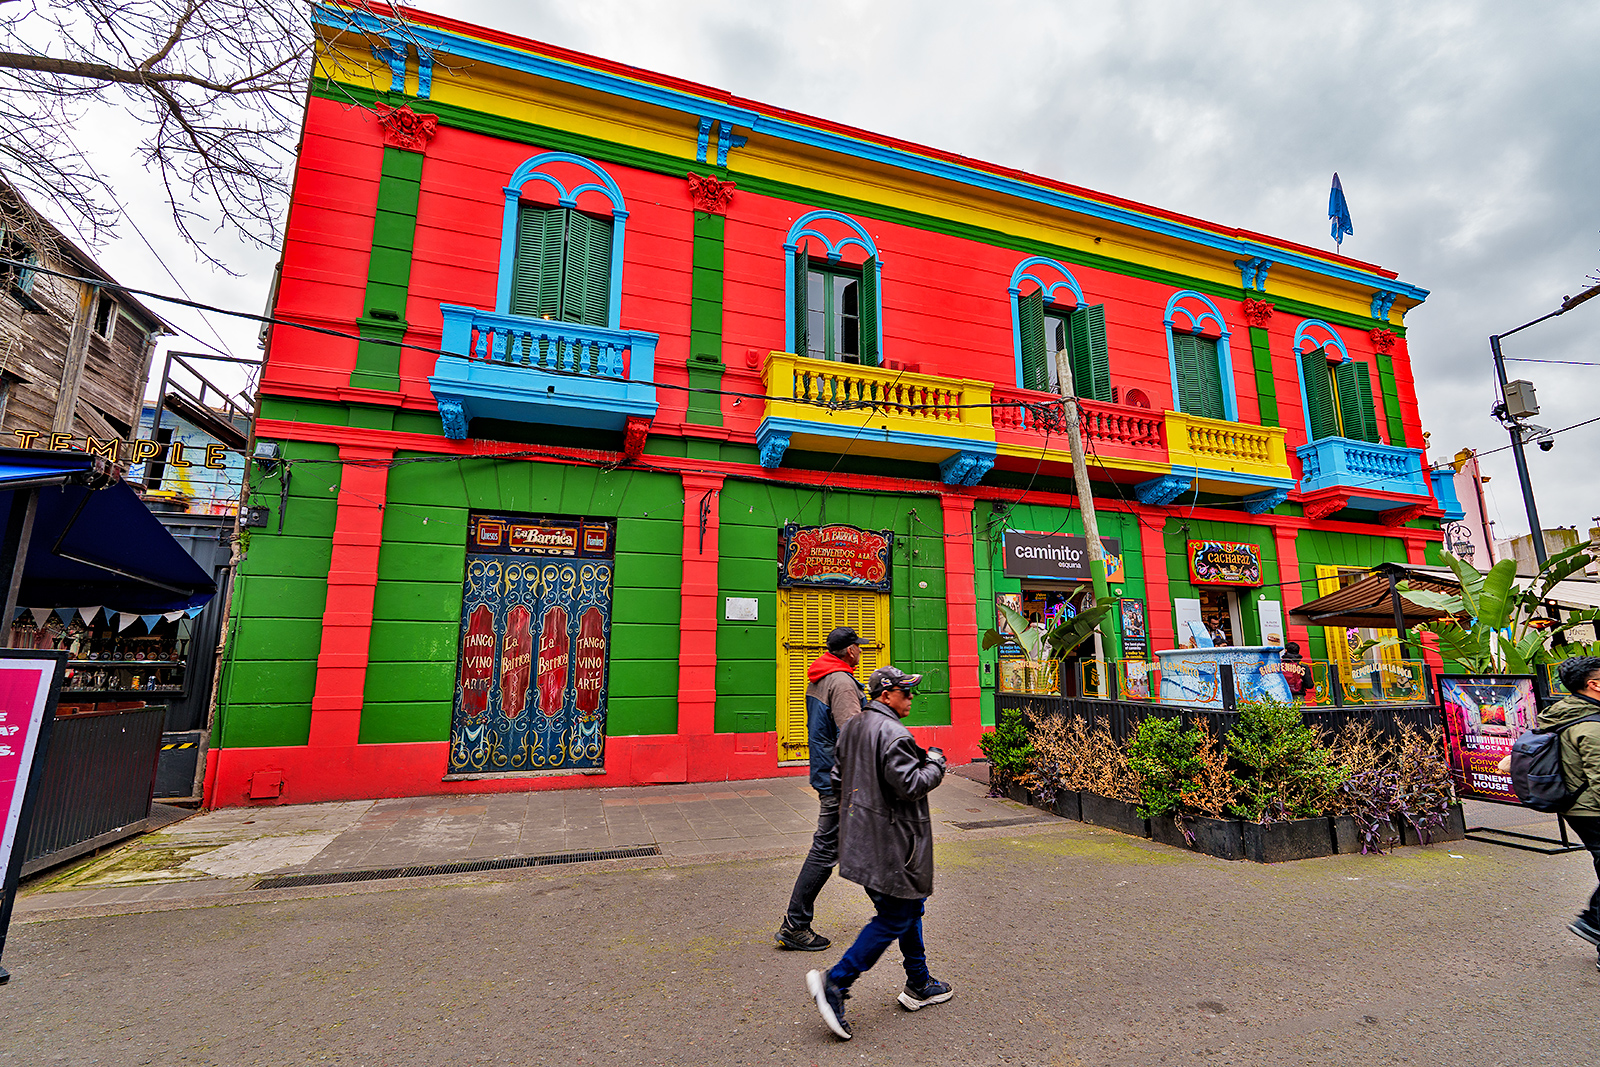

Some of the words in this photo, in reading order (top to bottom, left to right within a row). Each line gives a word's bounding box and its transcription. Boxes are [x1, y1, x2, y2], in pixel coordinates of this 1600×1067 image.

[14, 429, 228, 469] TEMPLE
[513, 528, 528, 539] La
[523, 529, 573, 546] Barrica
[821, 532, 831, 543] LA
[832, 531, 859, 544] BARRICA
[510, 547, 576, 556] VINOS
[1015, 544, 1080, 562] caminito
[806, 557, 851, 567] REPUBLICA
[1058, 561, 1082, 569] esquina
[823, 566, 853, 576] BOCA
[465, 634, 494, 648] TANGO
[504, 635, 518, 652] La
[540, 635, 555, 652] La
[578, 636, 605, 650] TANGO
[466, 656, 493, 669] VINO
[502, 653, 531, 675] Barrica
[538, 653, 569, 675] Barrica
[578, 656, 602, 669] VINO
[1132, 662, 1161, 676] ESQUINA
[1164, 661, 1199, 678] CAMINITO
[1258, 662, 1306, 677] BIENVENIDOS
[1352, 663, 1382, 679] REPUBLICA
[1396, 666, 1412, 678] BOCA
[577, 677, 601, 690] ARTE
[1470, 757, 1499, 767] Conve
[1471, 764, 1506, 774] Histó
[1472, 772, 1513, 784] TENEME
[1473, 781, 1509, 791] HOUSE
